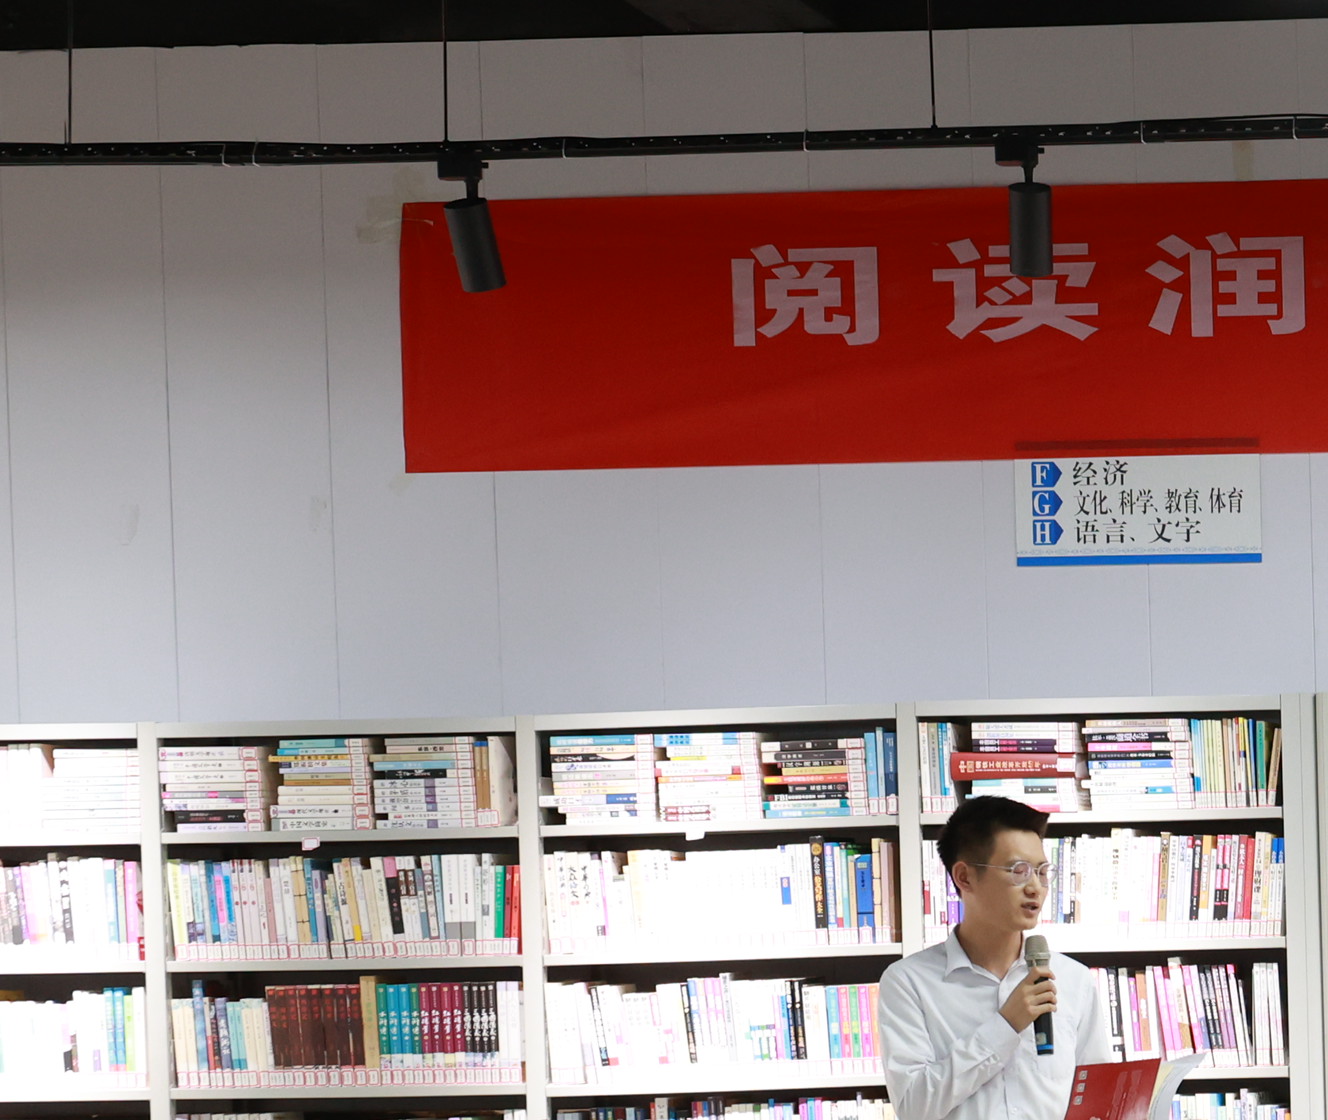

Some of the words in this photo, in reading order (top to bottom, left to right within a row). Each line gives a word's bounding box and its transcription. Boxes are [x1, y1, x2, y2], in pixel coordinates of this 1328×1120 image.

[1034, 463, 1050, 486] F
[1072, 459, 1128, 486] 经济
[1034, 492, 1051, 516] G
[1073, 487, 1244, 516] 文化、科学、教育、体育
[1035, 521, 1051, 544] H
[1074, 517, 1201, 545] 语言、文字
